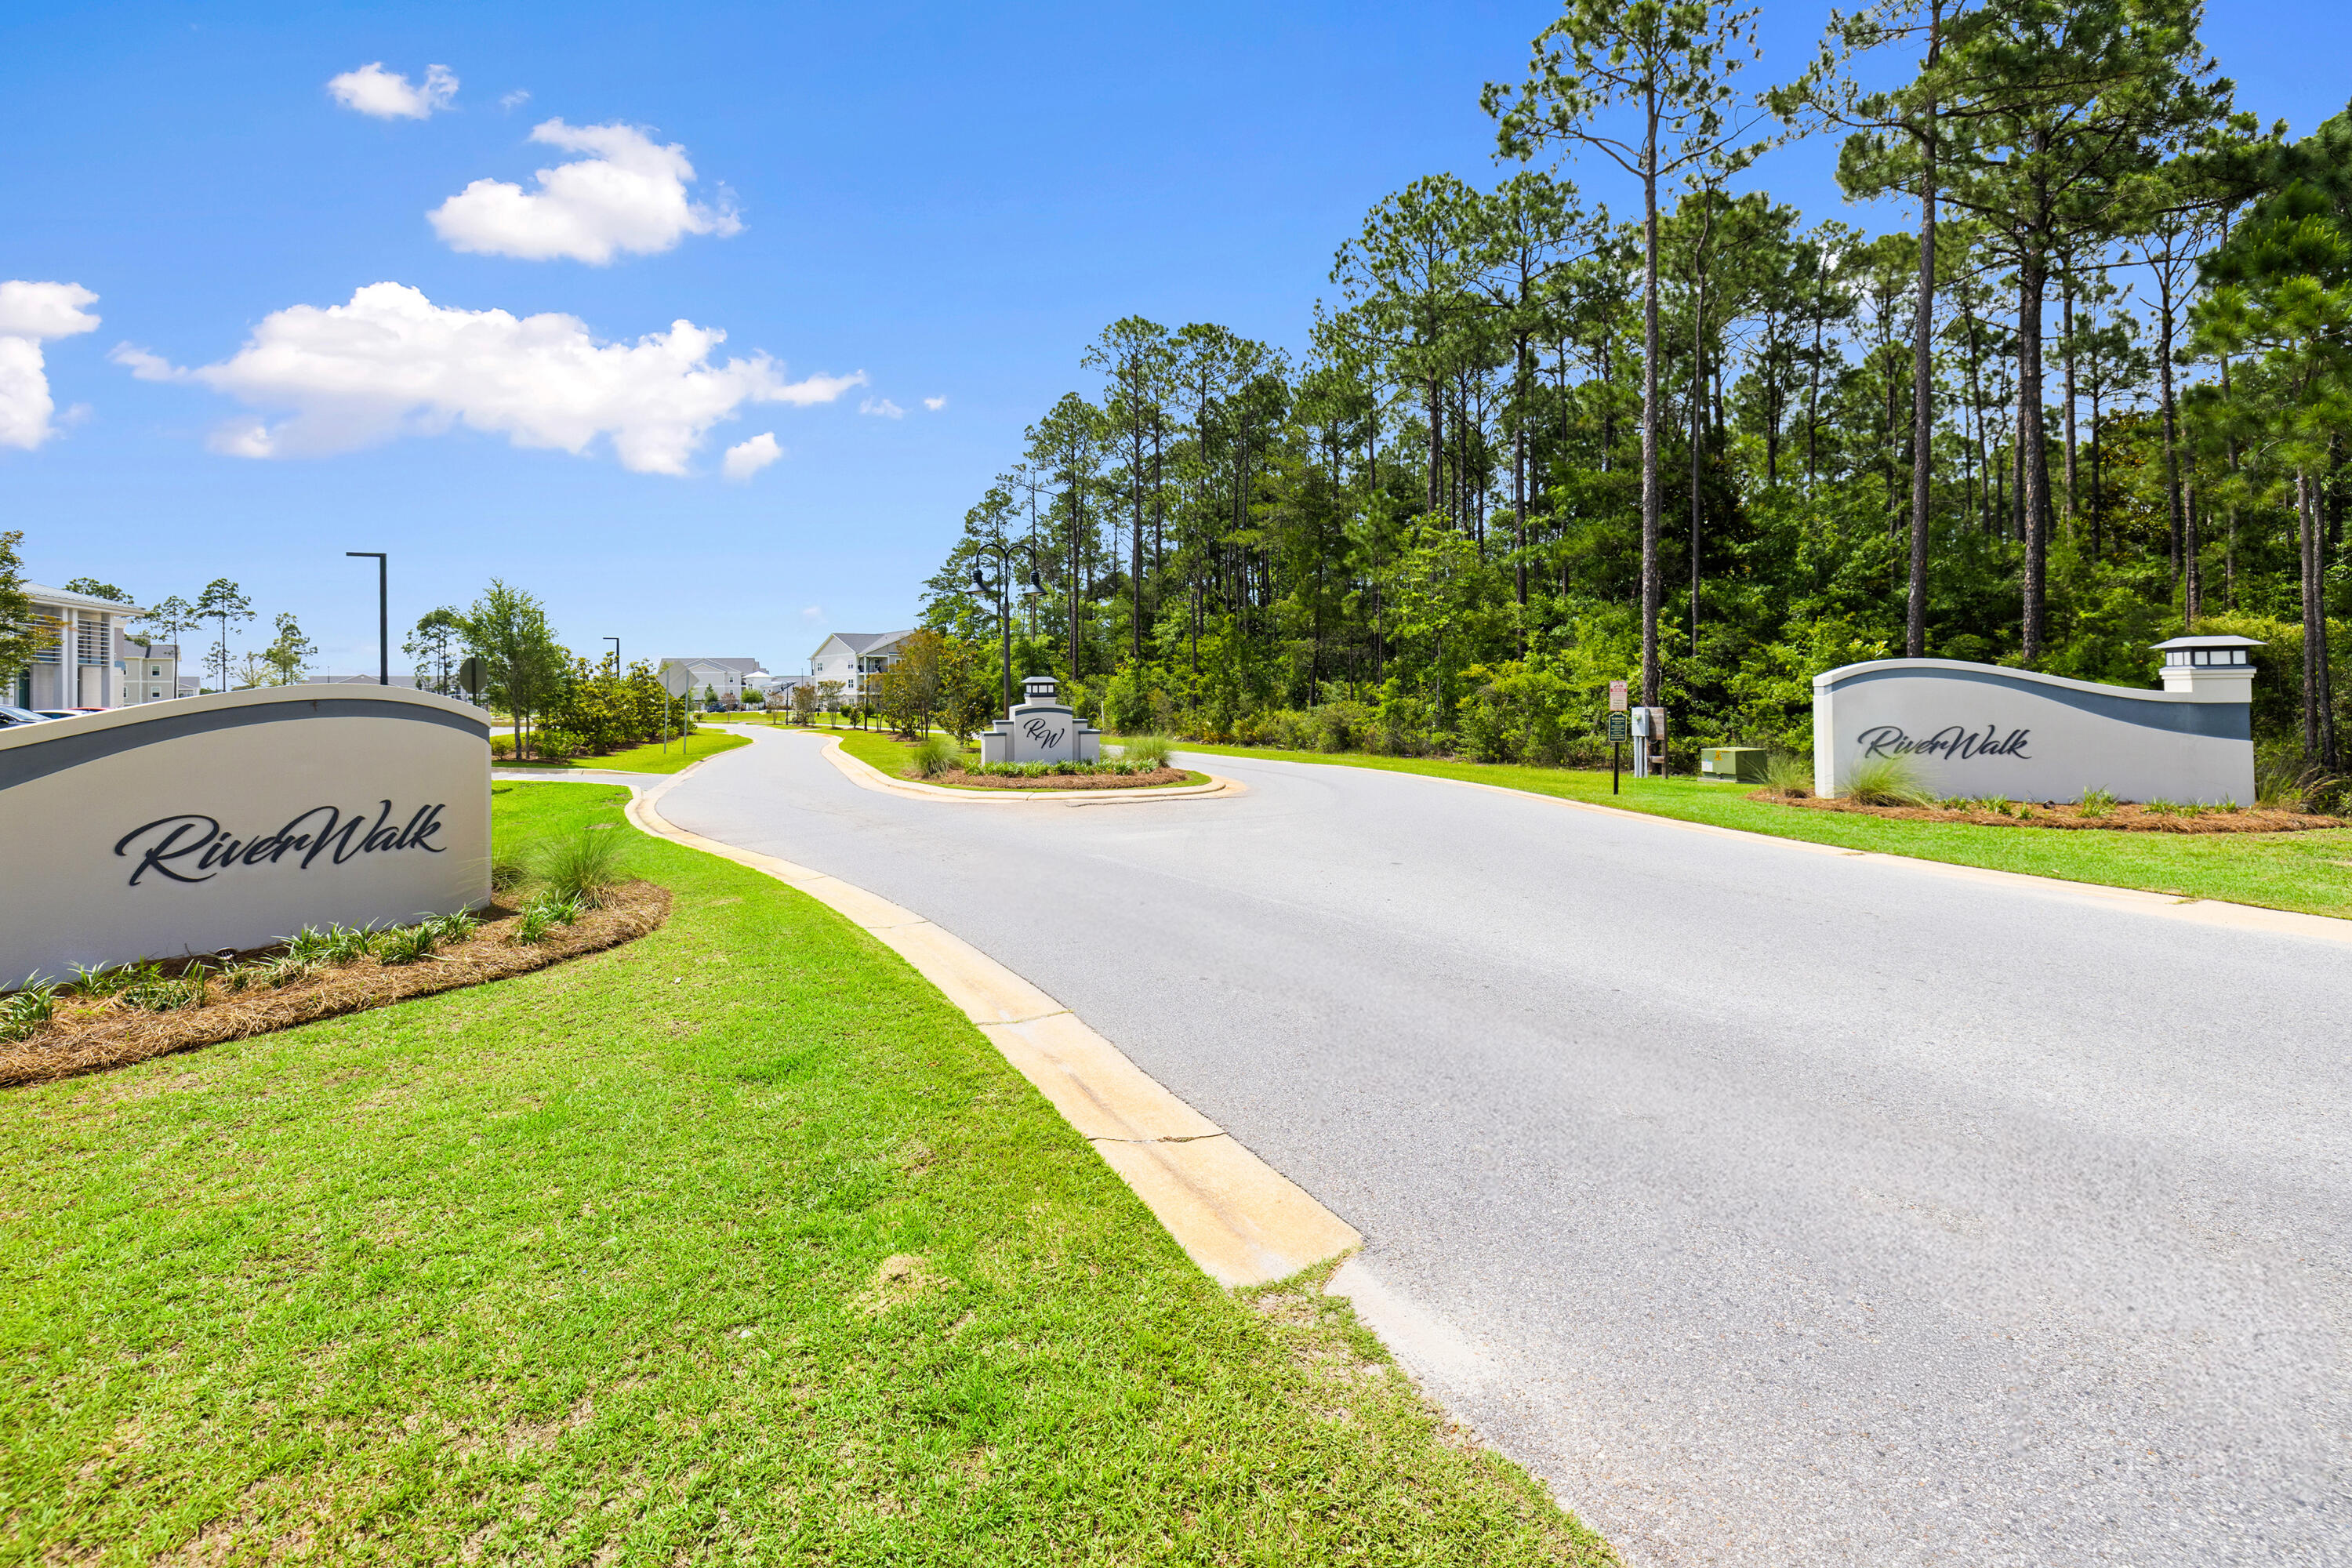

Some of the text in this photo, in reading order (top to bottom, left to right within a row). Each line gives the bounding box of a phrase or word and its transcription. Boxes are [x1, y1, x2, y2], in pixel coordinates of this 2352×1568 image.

[1023, 718, 1065, 750] RW
[1857, 724, 2032, 760] RiverWalk
[114, 800, 447, 887] RiverWalk
